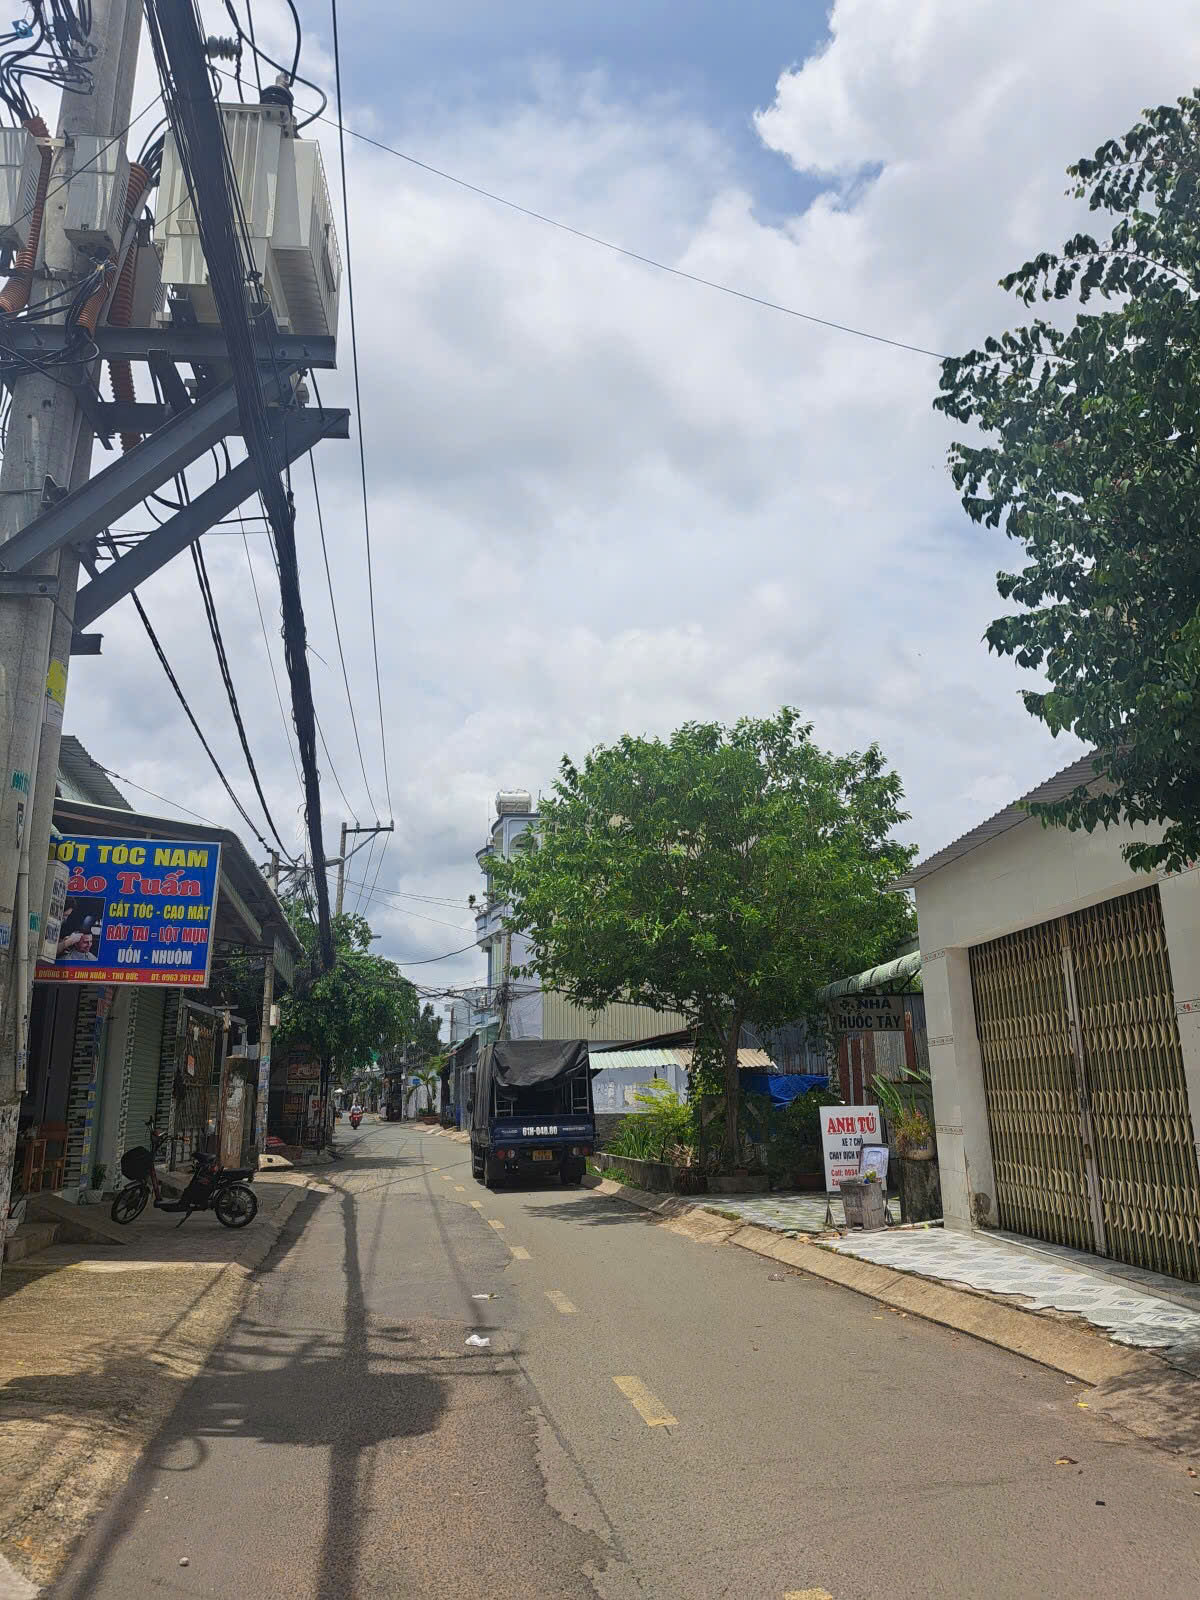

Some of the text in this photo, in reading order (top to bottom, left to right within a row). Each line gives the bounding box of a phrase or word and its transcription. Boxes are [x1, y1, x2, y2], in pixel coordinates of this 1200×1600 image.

[98, 843, 146, 865] TÓC
[154, 848, 209, 868] NAM
[66, 866, 201, 897] ảo Tuấn
[133, 902, 153, 919] TÓC
[163, 904, 185, 921] CẠO
[187, 905, 211, 923] MẶT
[132, 926, 150, 942] TAI
[181, 927, 208, 946] MỤN
[117, 944, 141, 964] UỐN
[151, 948, 192, 967] NHUỘM
[876, 1012, 901, 1029] TÂY
[827, 1116, 857, 1135] ANH
